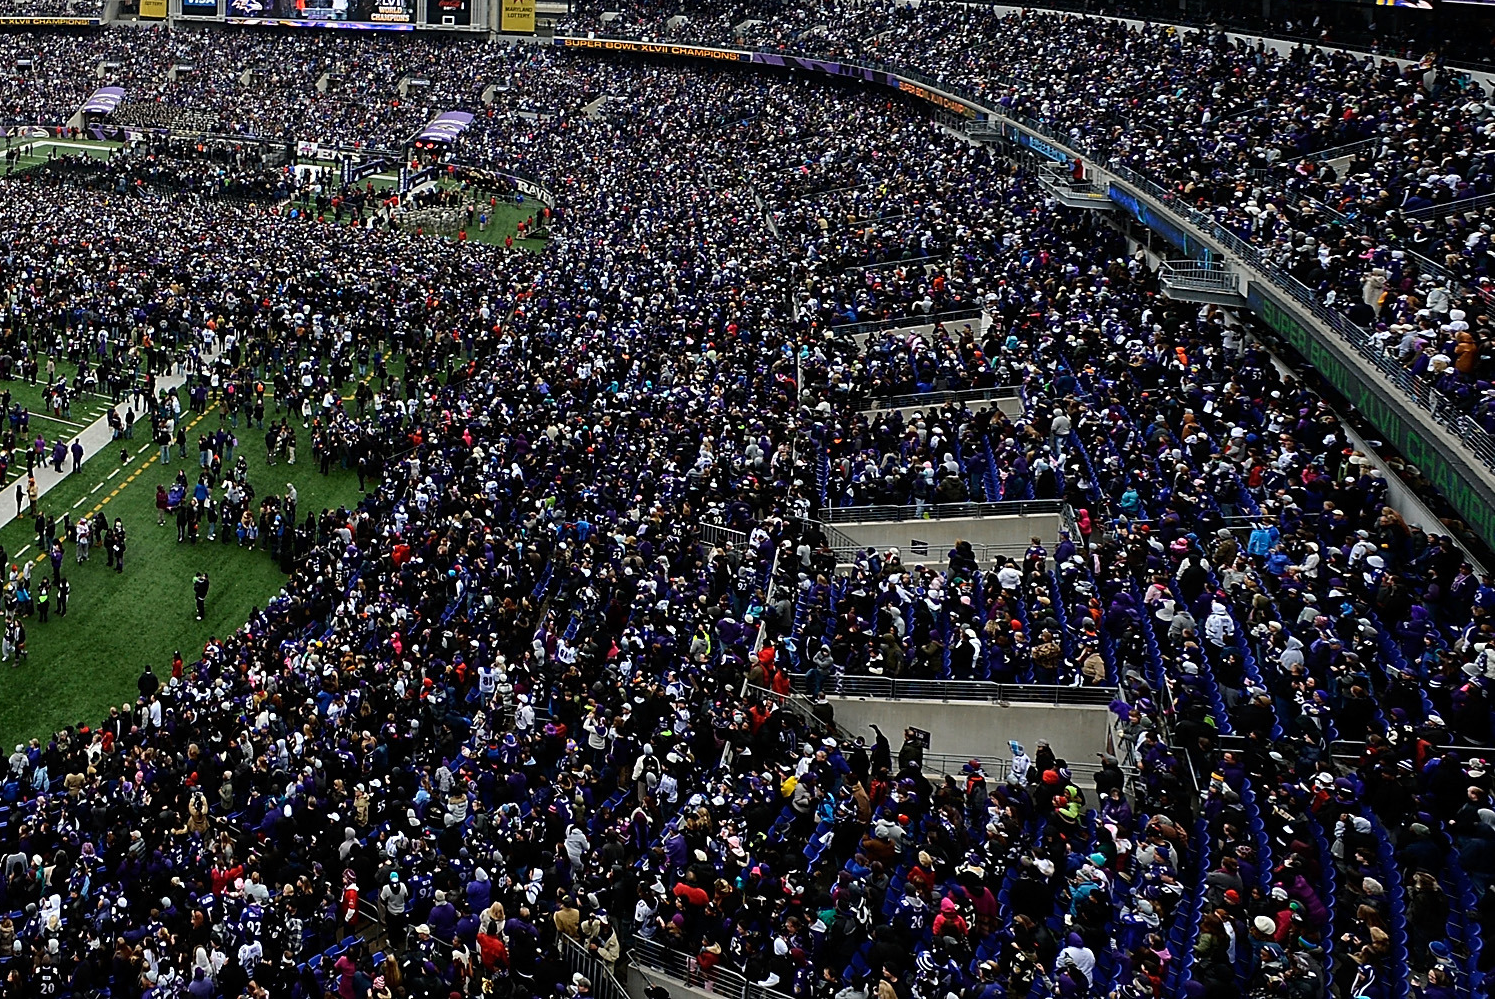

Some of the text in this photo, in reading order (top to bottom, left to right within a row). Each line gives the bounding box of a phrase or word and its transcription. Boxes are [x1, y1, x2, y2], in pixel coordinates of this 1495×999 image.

[378, 6, 403, 14] WORLD
[370, 13, 410, 22] CHAMPIONS
[564, 39, 741, 61] SUPER BOWL XLVII CHAMPIONS!
[1262, 300, 1307, 356] SUPER
[1310, 342, 1352, 400] BOWL
[1357, 385, 1401, 448] XLVII
[737, 582, 747, 591] 92
[482, 677, 493, 686] 81
[246, 920, 262, 936] 92
[910, 915, 924, 930] 20
[40, 982, 55, 995] 20
